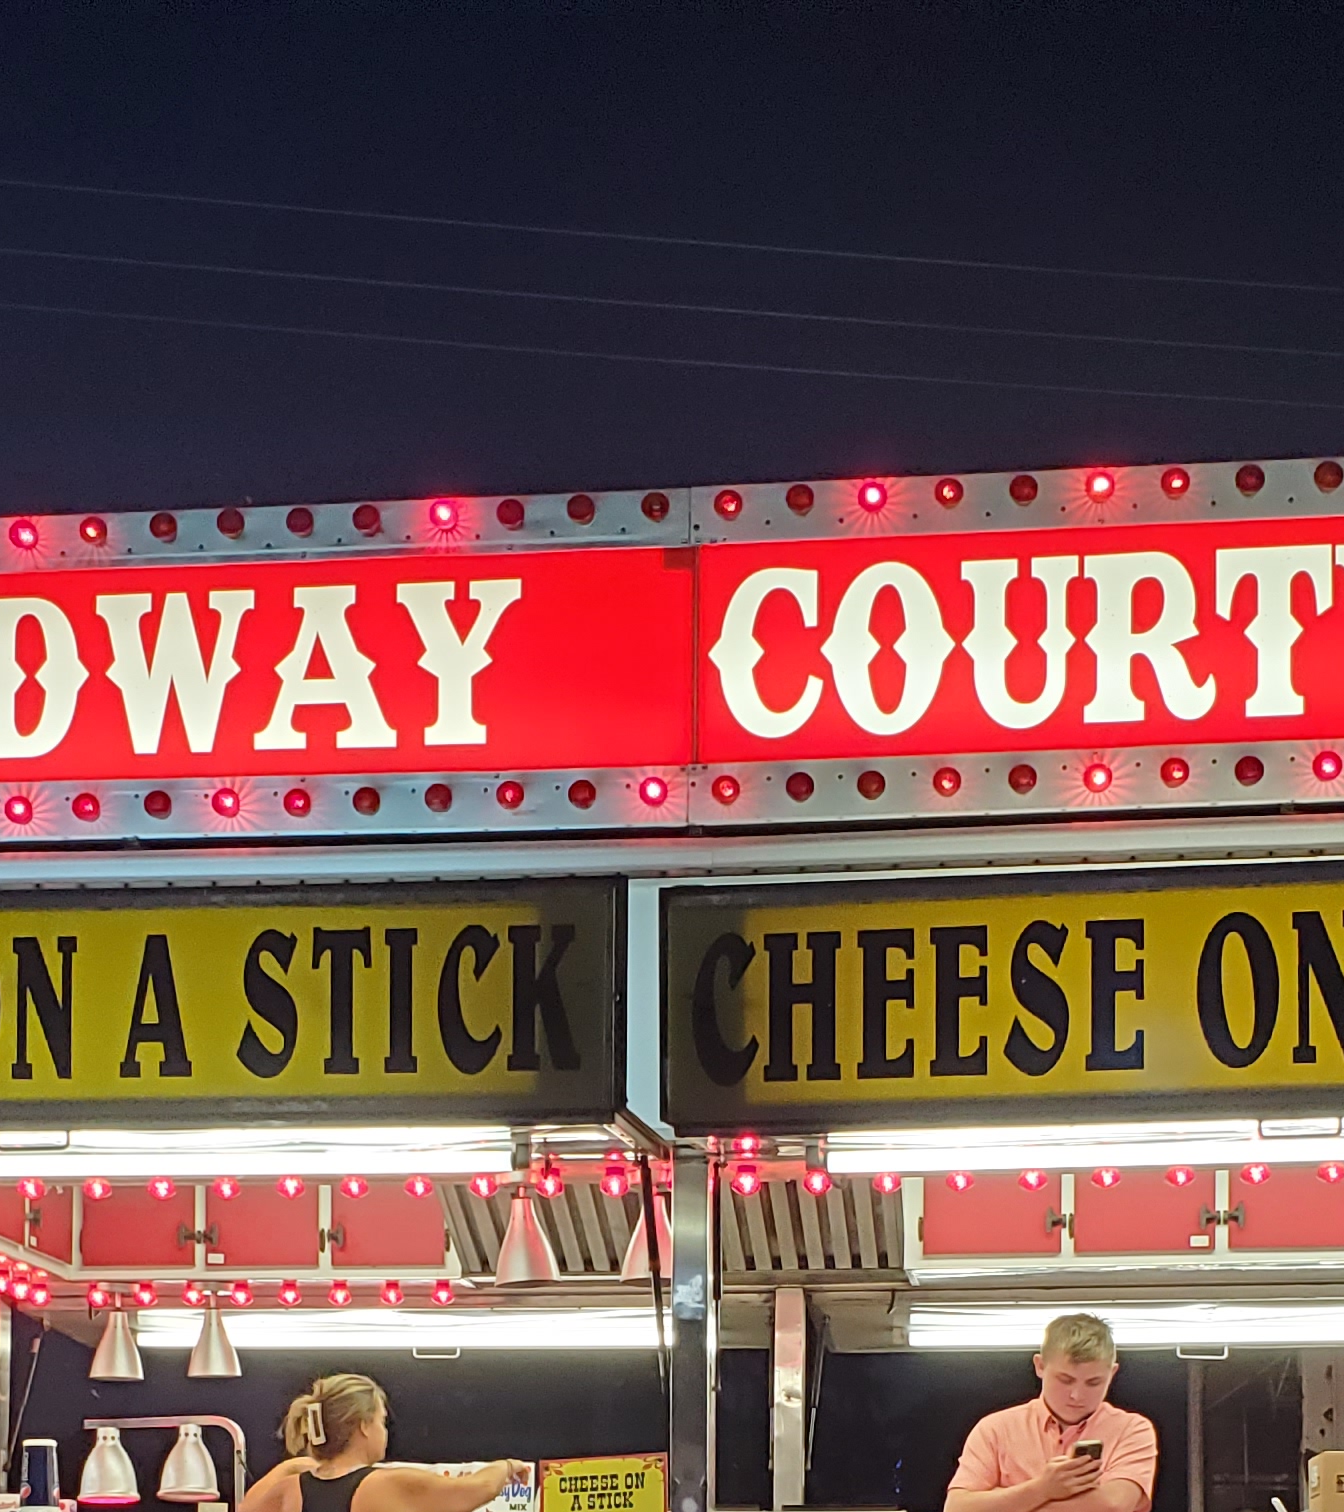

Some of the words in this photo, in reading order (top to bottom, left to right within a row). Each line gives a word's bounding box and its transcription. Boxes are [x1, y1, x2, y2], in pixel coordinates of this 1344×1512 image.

[120, 935, 192, 1078] A
[236, 922, 580, 1078] STICK
[691, 918, 1145, 1087] CHEESE
[559, 1474, 620, 1493] CHEESE
[624, 1472, 646, 1490] ON
[570, 1494, 582, 1512] A
[588, 1492, 634, 1510] STICK
